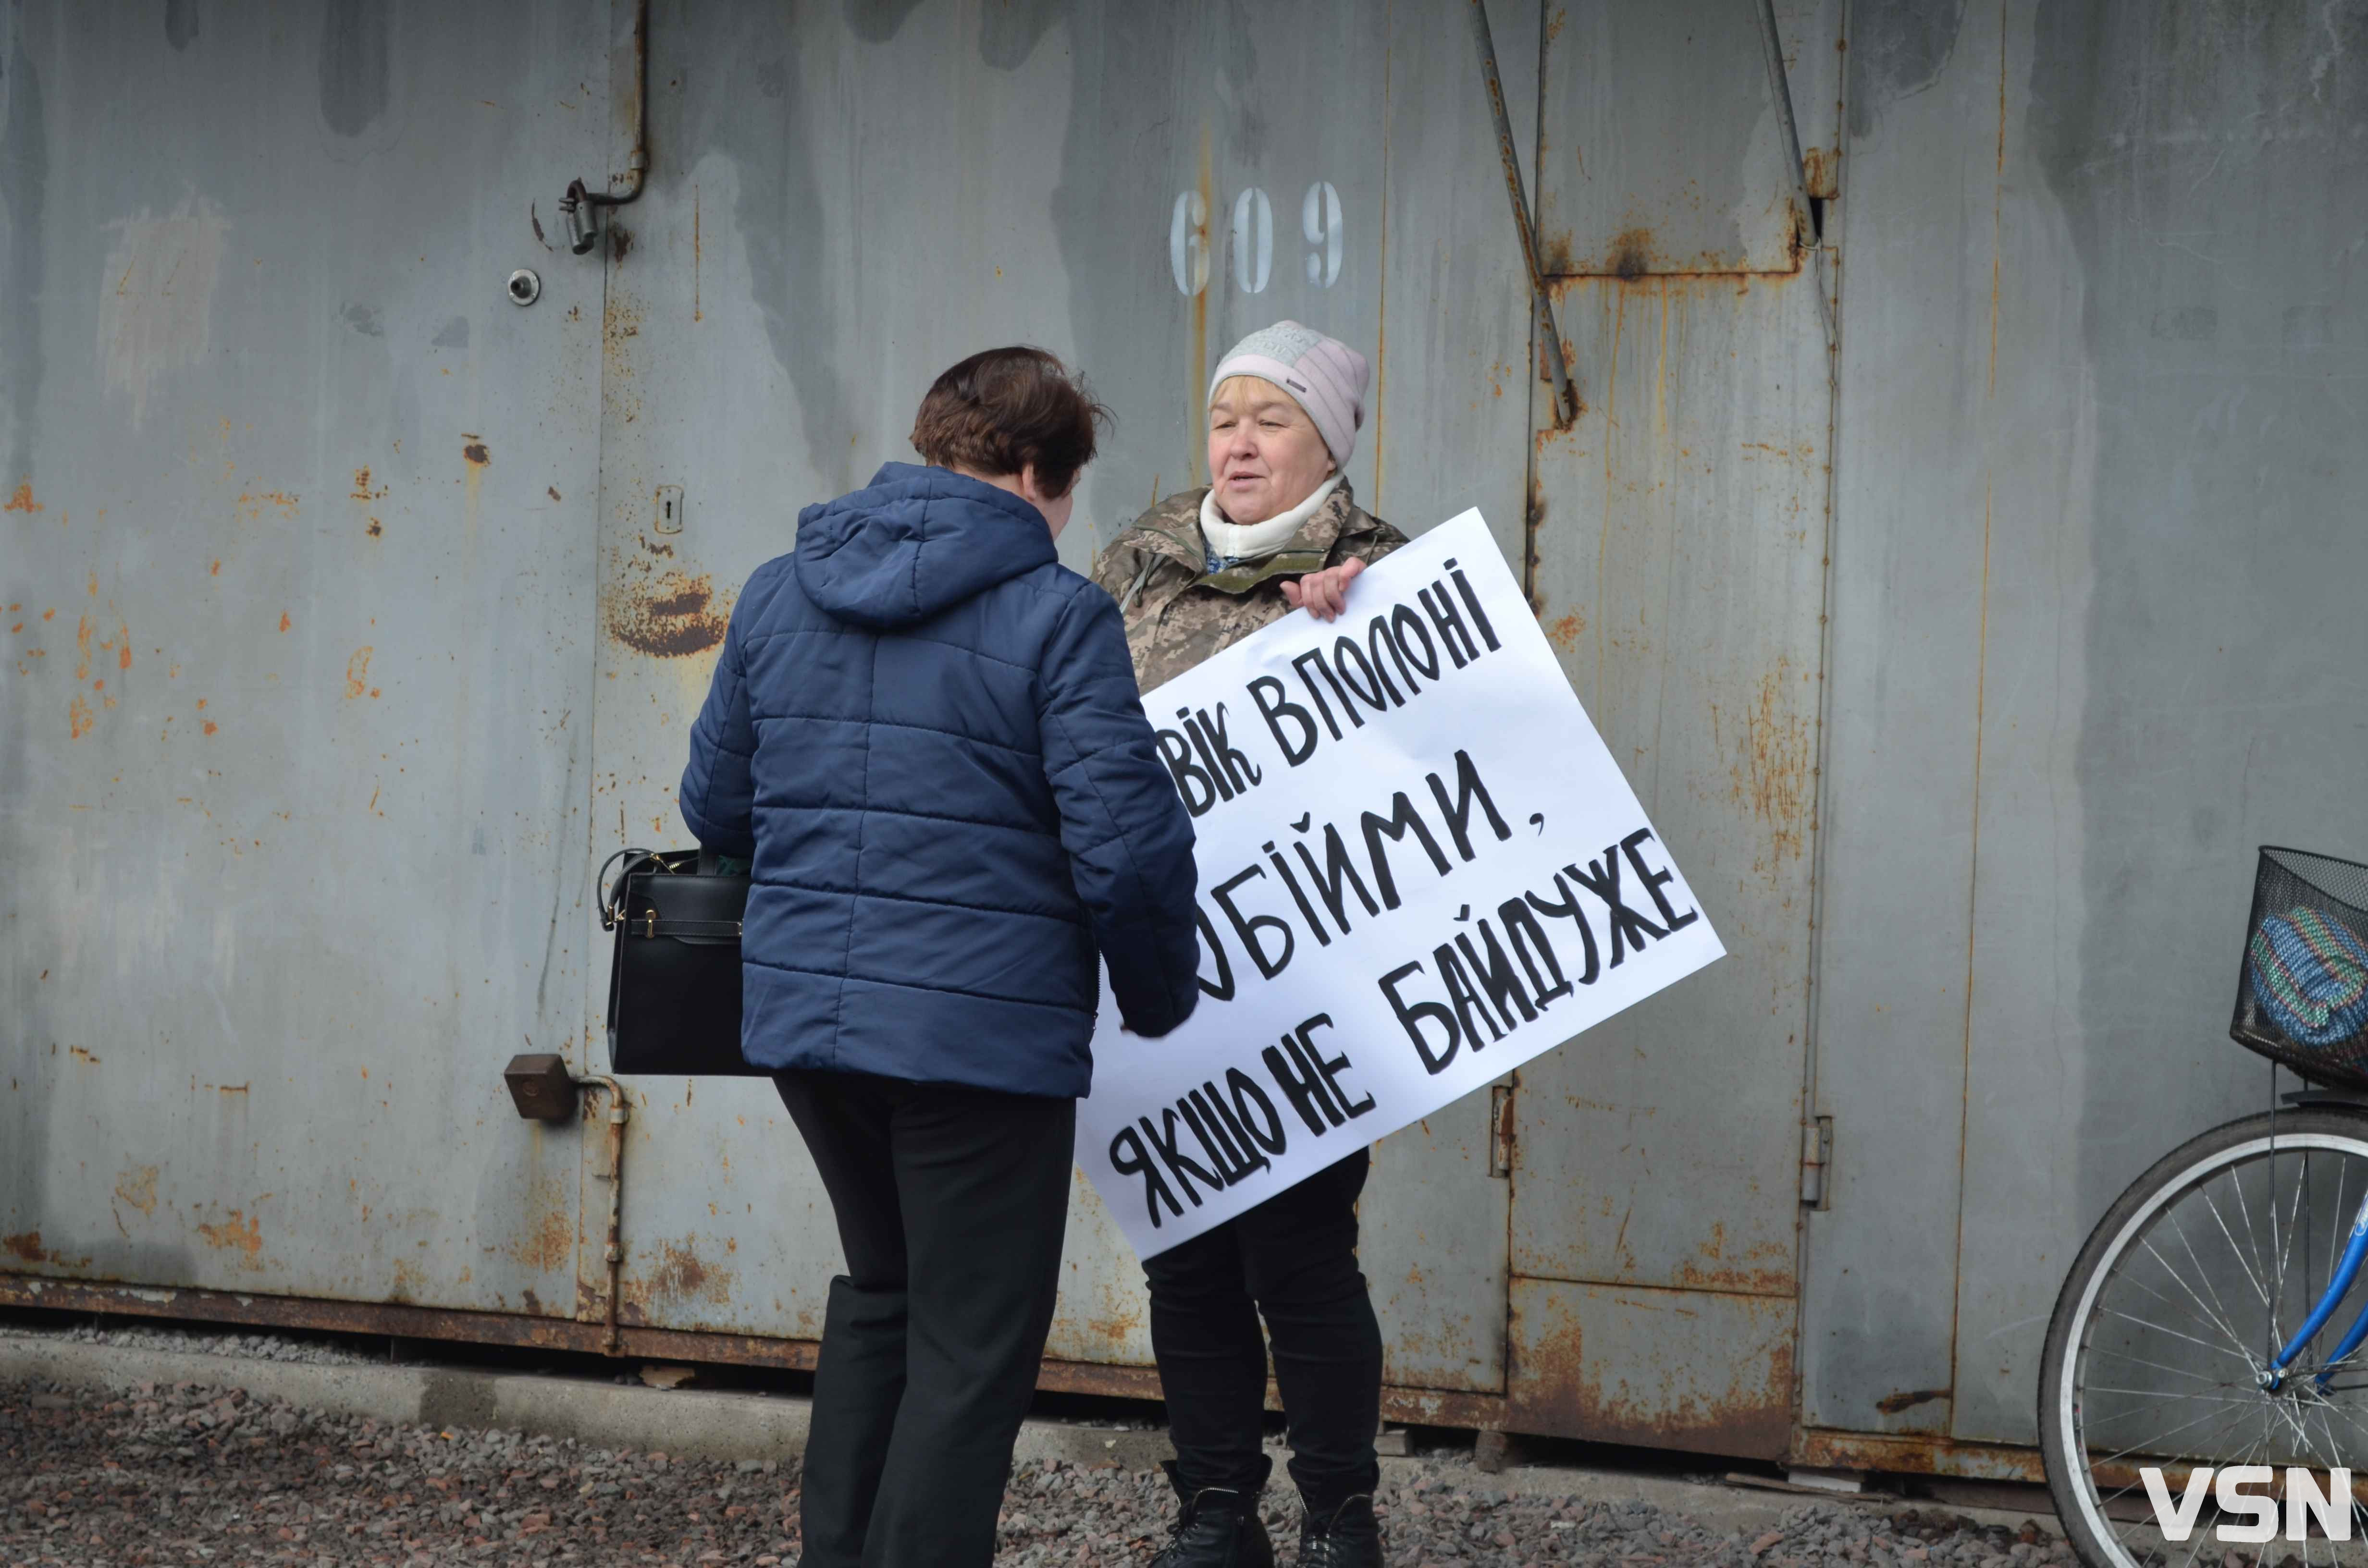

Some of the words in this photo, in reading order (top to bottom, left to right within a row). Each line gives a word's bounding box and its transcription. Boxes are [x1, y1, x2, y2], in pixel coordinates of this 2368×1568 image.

[1171, 181, 1343, 296] 609
[1154, 702, 1262, 818] ВІК
[1109, 1067, 1286, 1229] ЯКЩО
[1261, 1013, 1376, 1137] НЕ
[1378, 828, 1698, 1076] БАЙДУЖЕ
